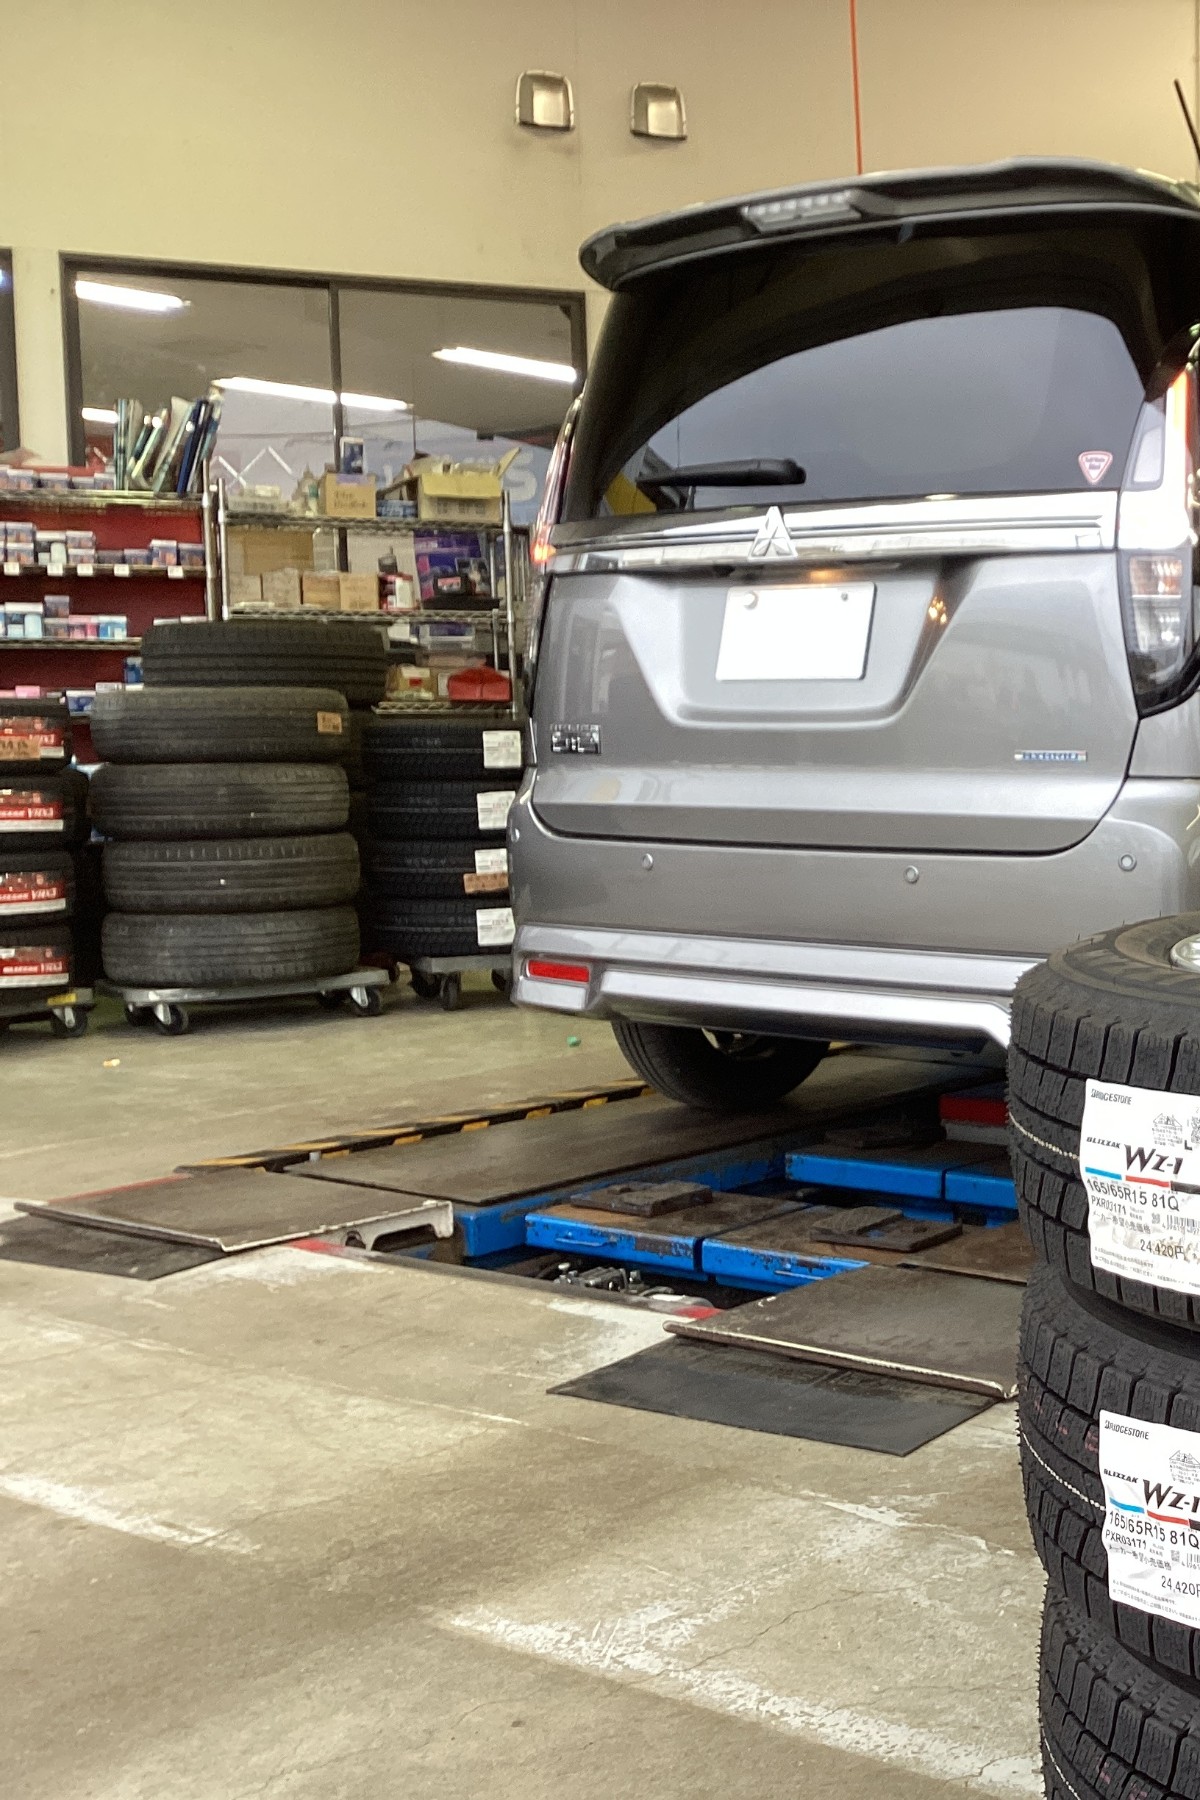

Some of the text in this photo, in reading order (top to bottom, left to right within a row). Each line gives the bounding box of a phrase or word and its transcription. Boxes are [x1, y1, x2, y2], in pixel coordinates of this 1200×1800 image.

[1091, 1088, 1132, 1105] BRIDGESTONE
[1086, 1136, 1121, 1149] BLIZZAK
[1087, 1178, 1180, 1212] 165/65R15 81Q
[1091, 1195, 1127, 1215] PXR03171
[1104, 1419, 1149, 1440] BRIDGESTONE
[1104, 1468, 1138, 1484] BLIZZAK
[1105, 1529, 1147, 1549] PXR03171
[1109, 1511, 1200, 1549] 165/65R15 81Q
